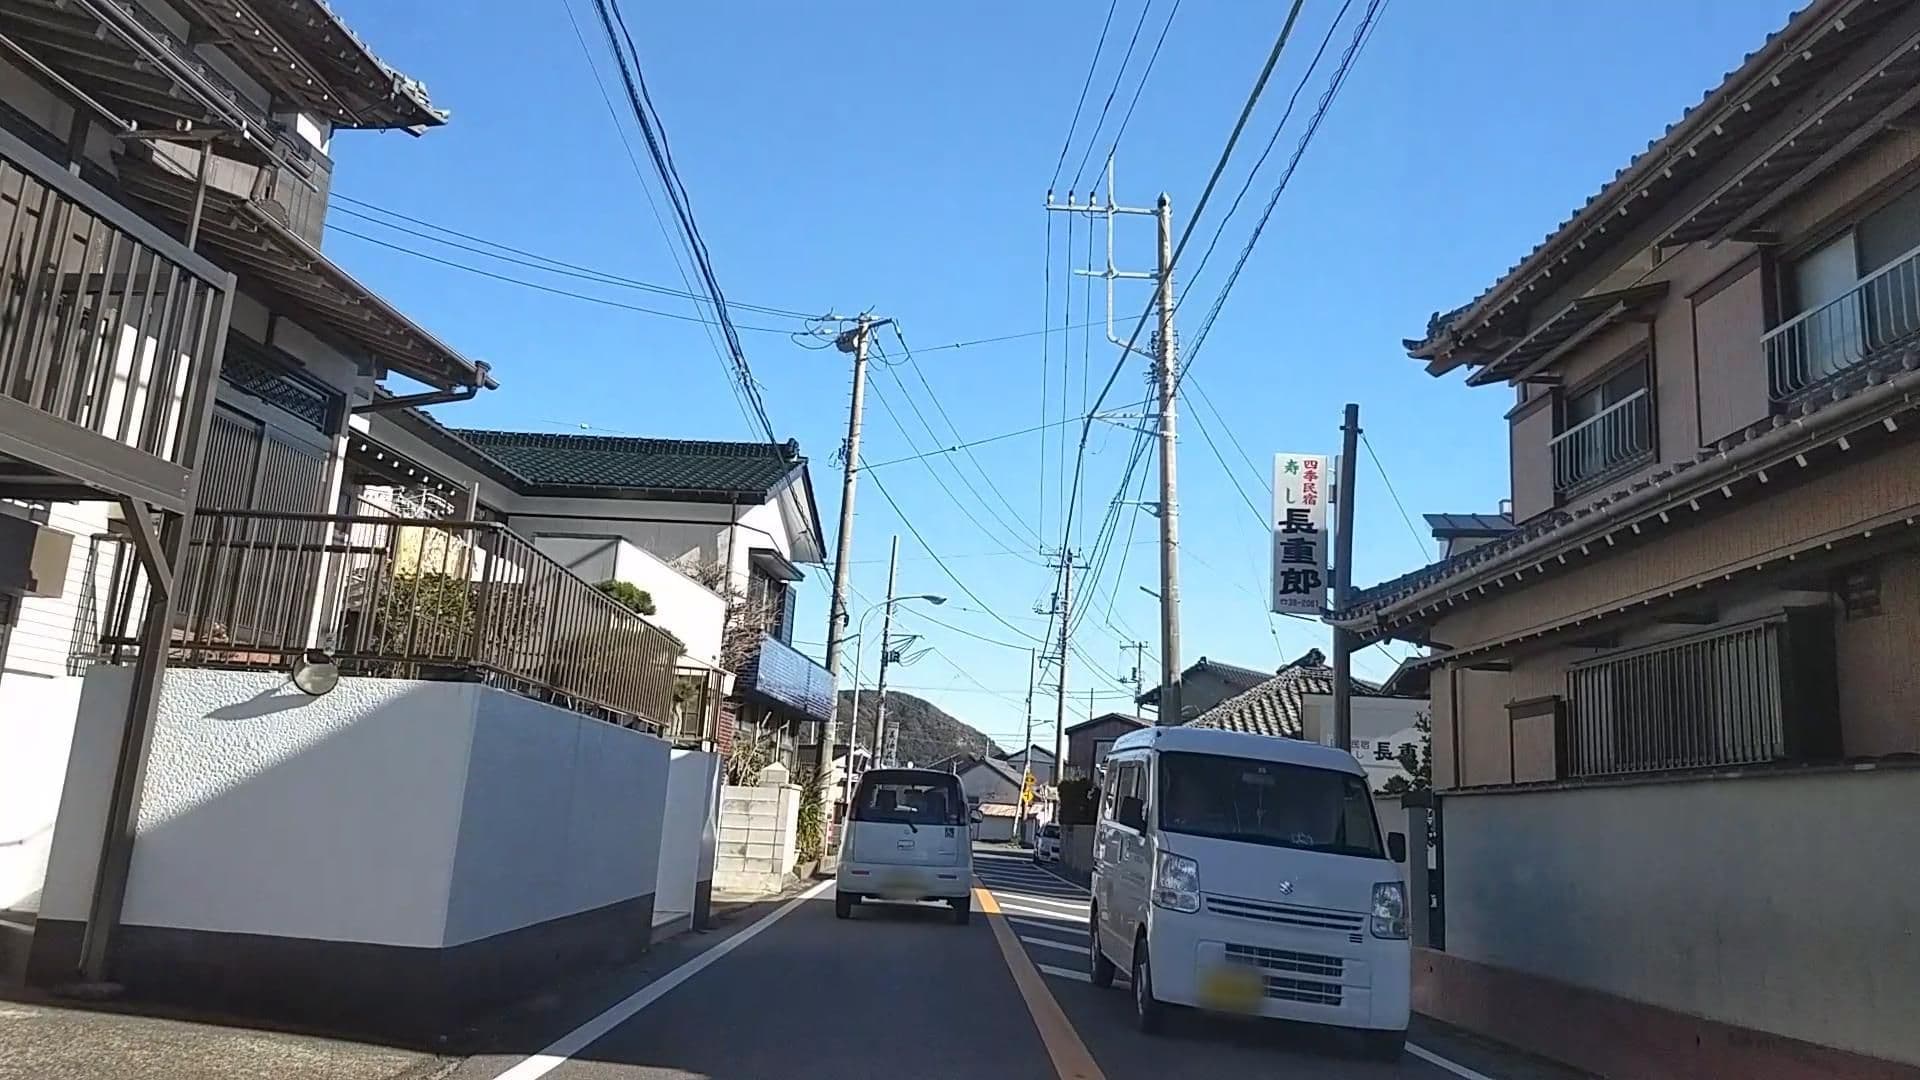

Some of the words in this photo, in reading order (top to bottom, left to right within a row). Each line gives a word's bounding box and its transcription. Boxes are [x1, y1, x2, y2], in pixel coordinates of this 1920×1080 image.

[1284, 458, 1299, 504] 寿し
[1302, 459, 1319, 506] 四季民宿
[1278, 508, 1322, 595] 長重郎
